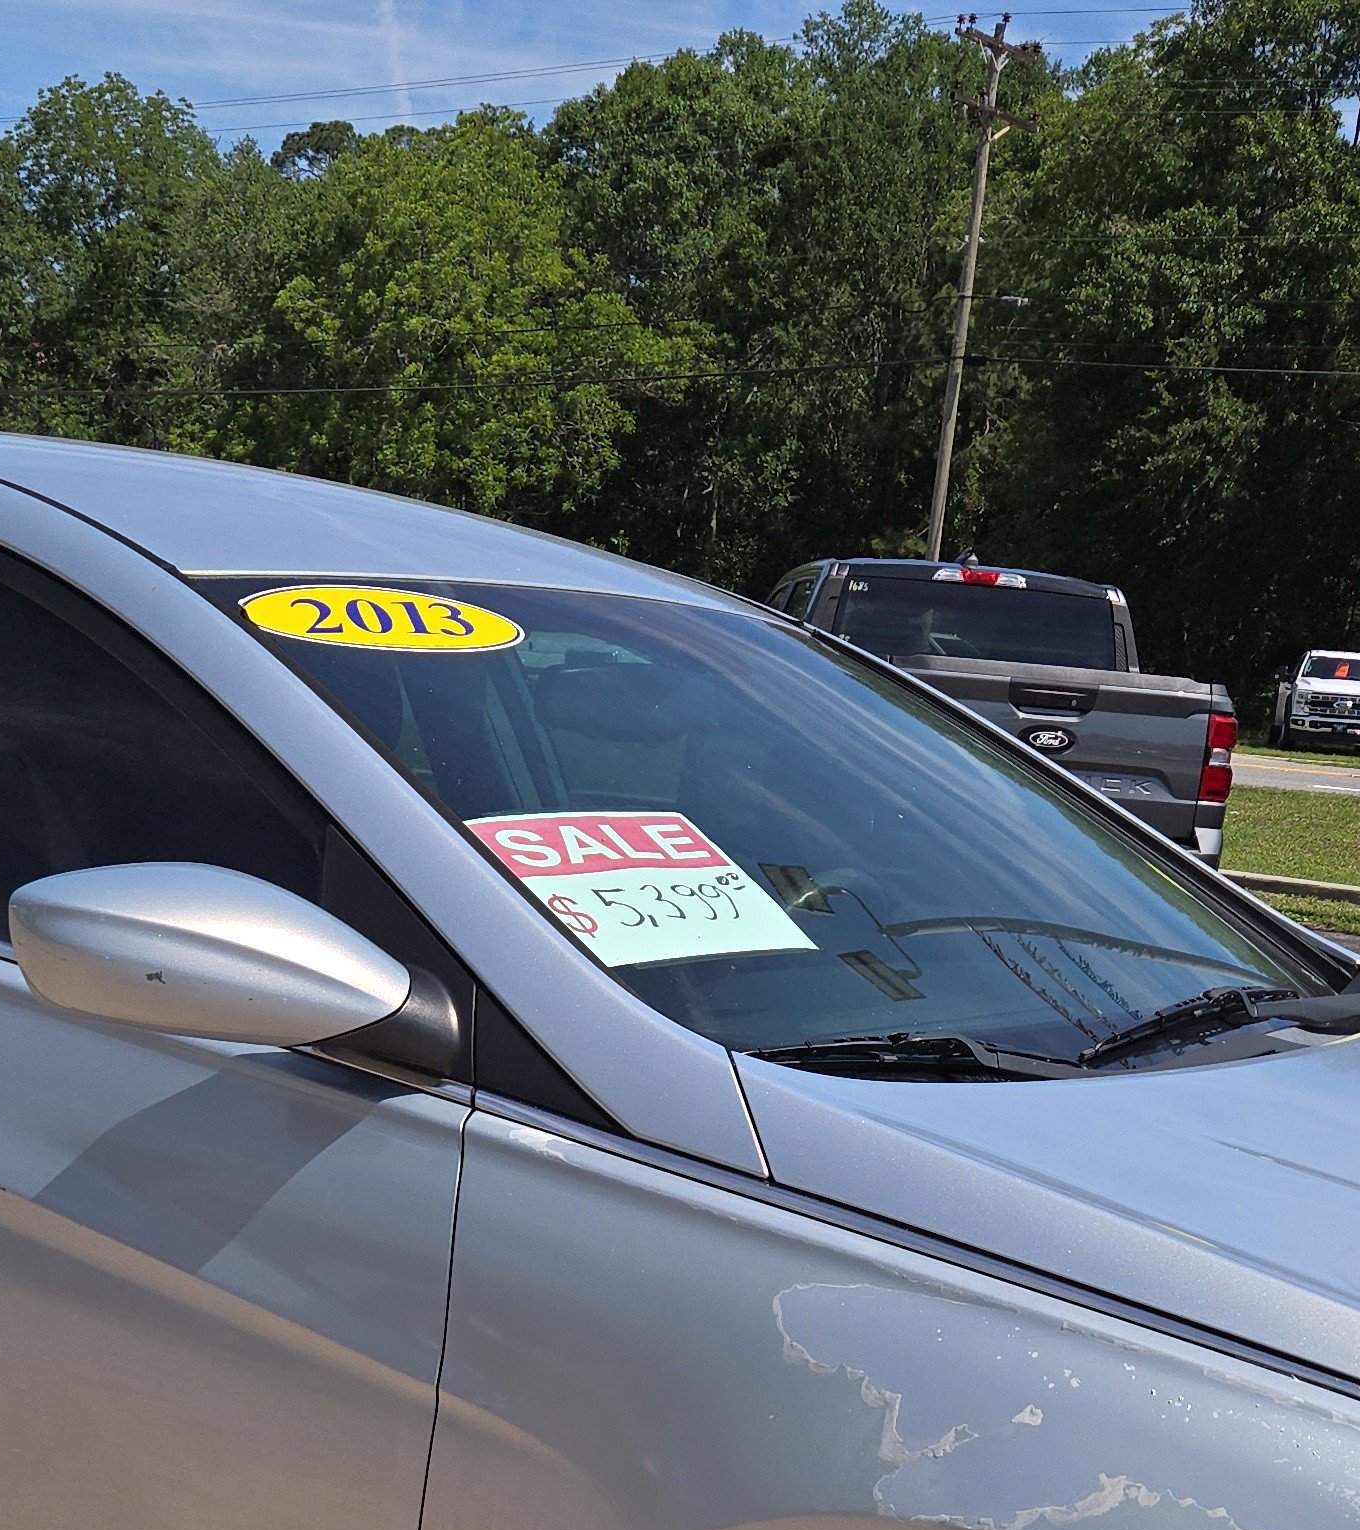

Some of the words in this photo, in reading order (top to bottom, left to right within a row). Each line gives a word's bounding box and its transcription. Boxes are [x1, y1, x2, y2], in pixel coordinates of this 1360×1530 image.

[290, 598, 475, 636] 2013
[1035, 732, 1063, 747] Ford
[494, 823, 712, 868] SALE
